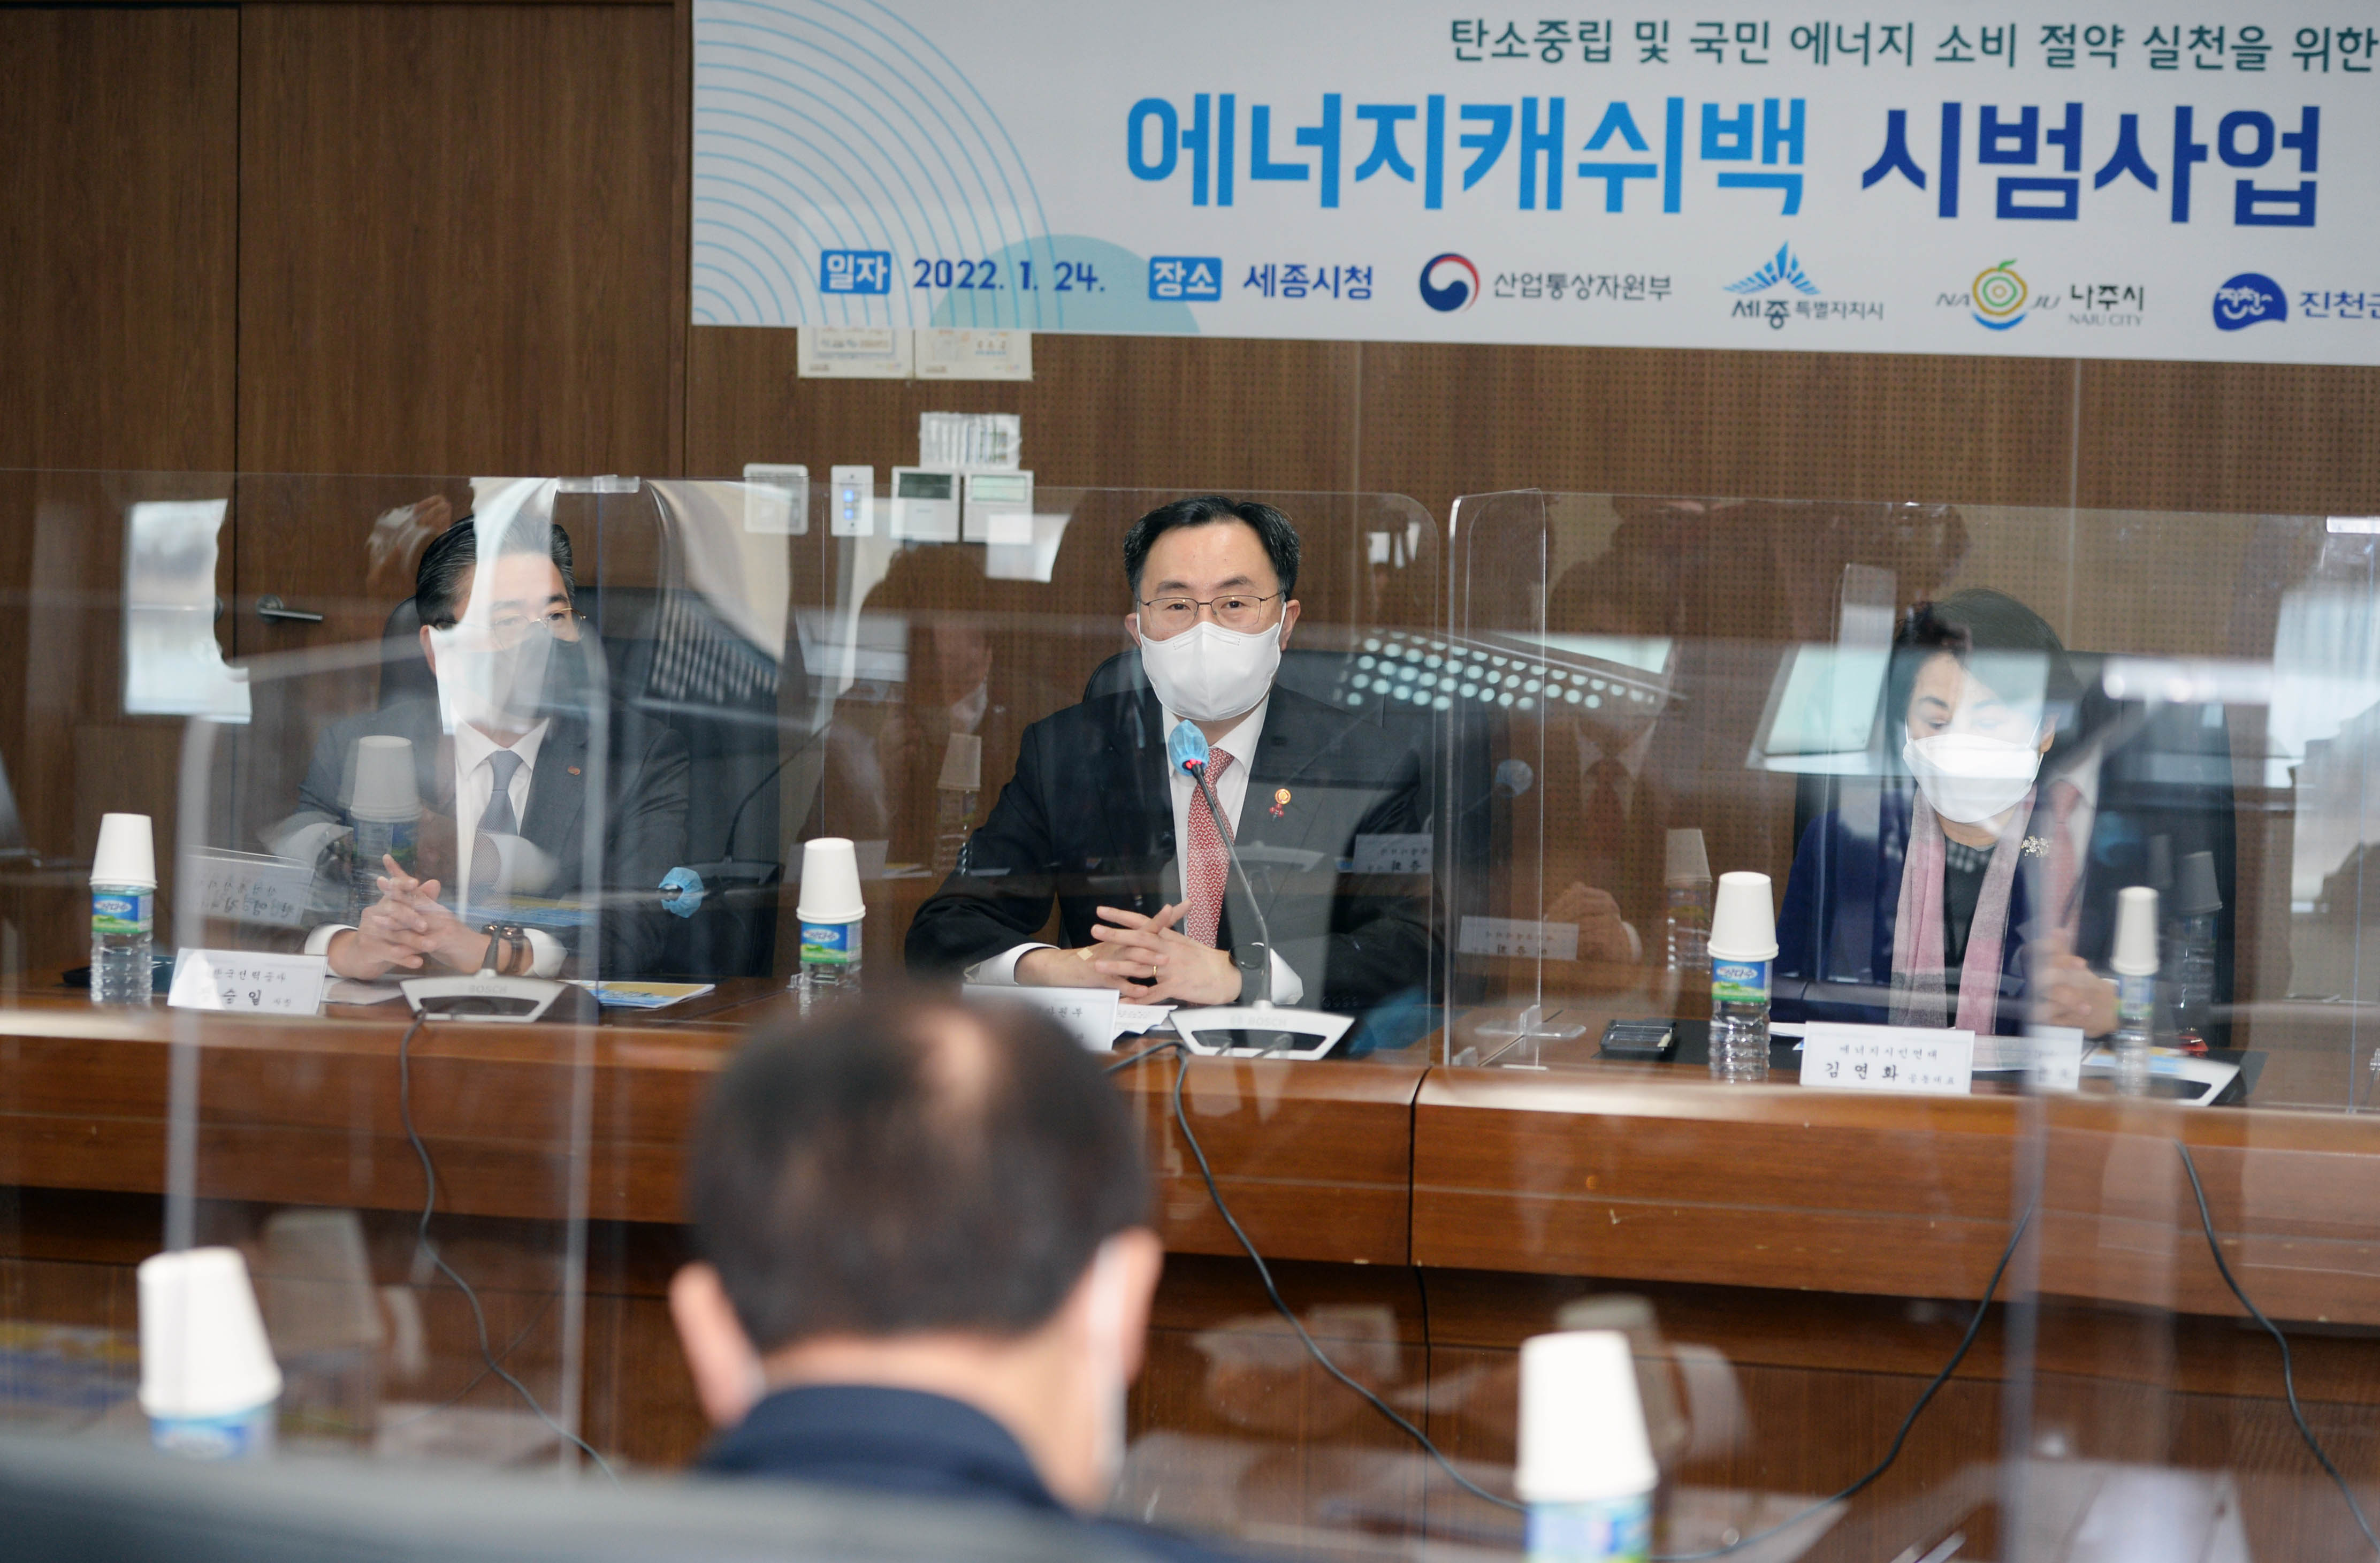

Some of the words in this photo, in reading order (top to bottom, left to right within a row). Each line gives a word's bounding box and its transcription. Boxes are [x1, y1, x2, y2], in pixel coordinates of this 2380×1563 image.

[1451, 18, 1612, 65] 탄소중립
[1634, 19, 1670, 65] 및
[1689, 20, 1770, 65] 국민
[1789, 20, 1914, 67] 에너지
[1934, 22, 2017, 69] 소비
[2039, 23, 2125, 69] 절약
[2142, 24, 2274, 72] 실천을
[2291, 26, 2379, 73] 위한
[1126, 92, 1807, 217] 에너지캐쉬백
[1861, 101, 2322, 228] 시범사업
[827, 254, 888, 291] 일자
[913, 258, 1004, 290] 2022.
[1019, 260, 1039, 292] 1.
[1053, 261, 1105, 293] 24.
[1154, 261, 1218, 298] 장소
[1242, 263, 1373, 301] 세종시청
[1494, 272, 1672, 301] 산업통상자원부
[2070, 284, 2144, 311] 나주시
